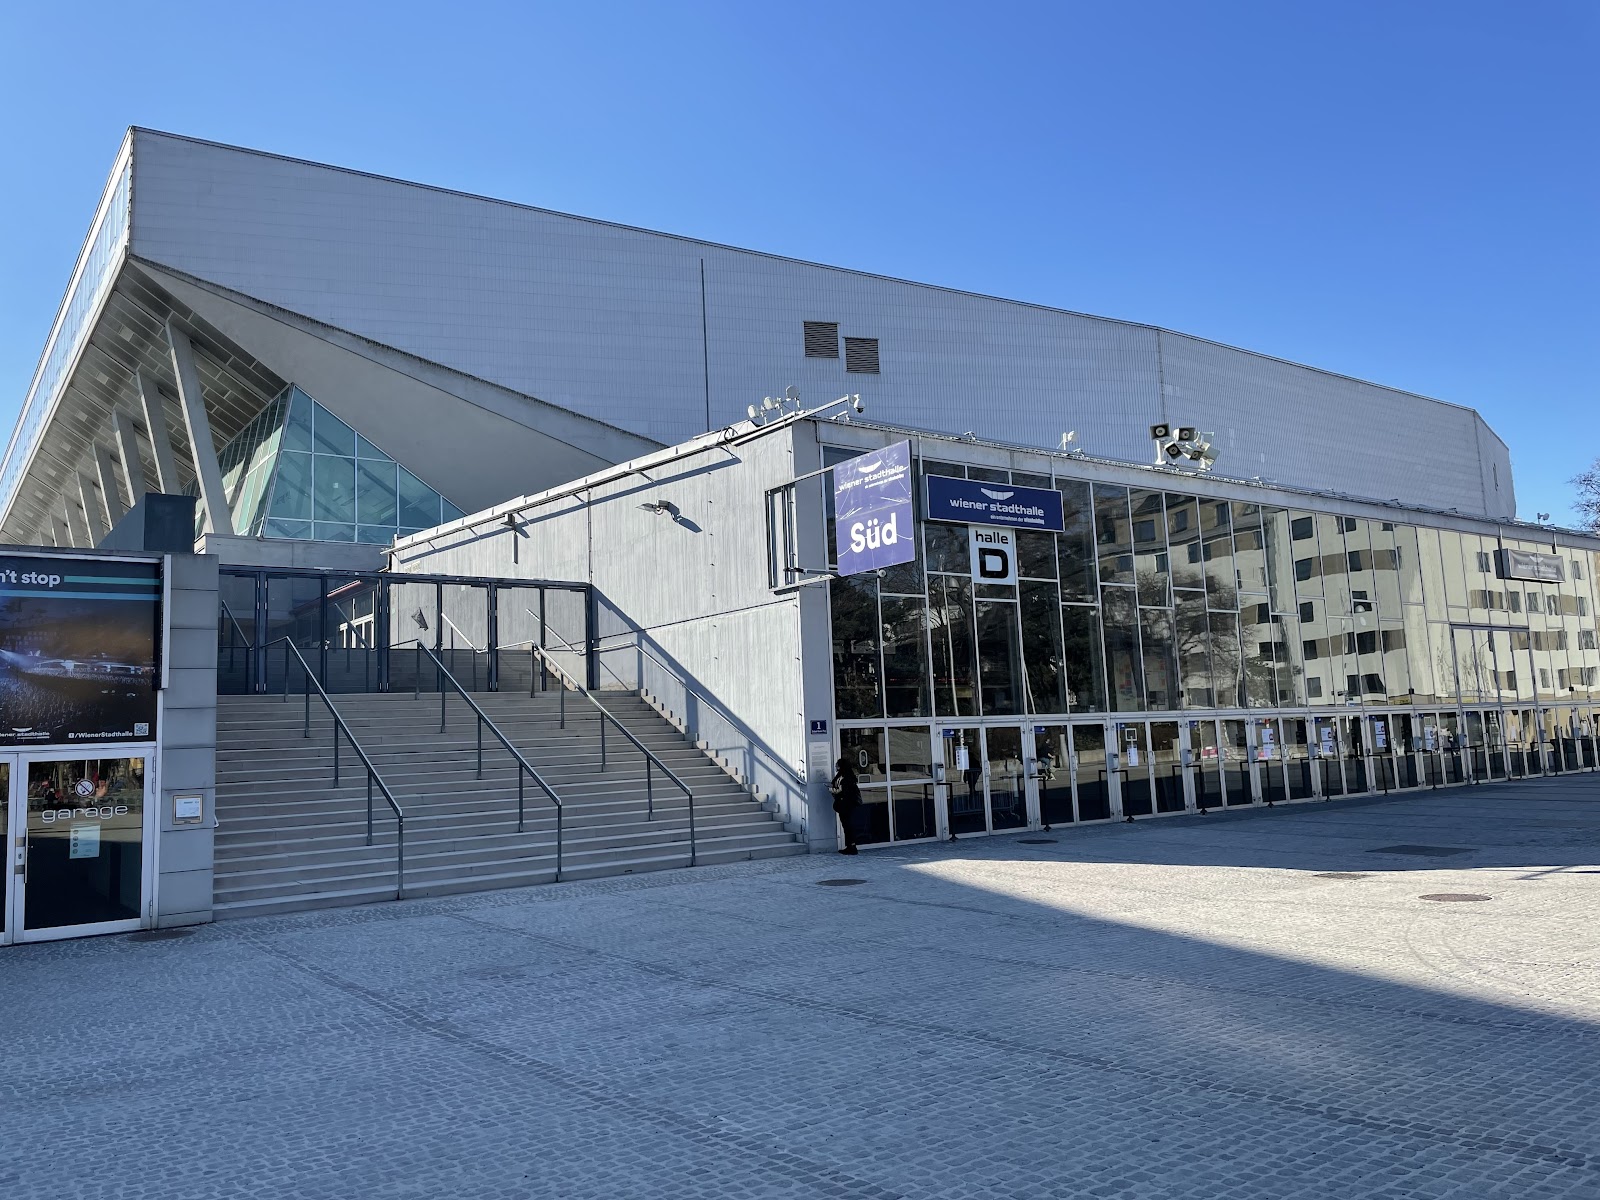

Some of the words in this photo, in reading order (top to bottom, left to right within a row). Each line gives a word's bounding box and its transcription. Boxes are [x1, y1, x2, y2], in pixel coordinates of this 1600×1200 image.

[838, 478, 863, 491] wiener
[864, 465, 904, 483] stadthalle
[949, 498, 988, 511] wiener
[989, 502, 1045, 516] stadthalle
[850, 512, 898, 554] Süd
[975, 530, 1009, 545] halle
[978, 547, 1009, 579] D
[21, 571, 61, 588] stop
[816, 721, 821, 730] 1
[41, 805, 129, 824] garage
